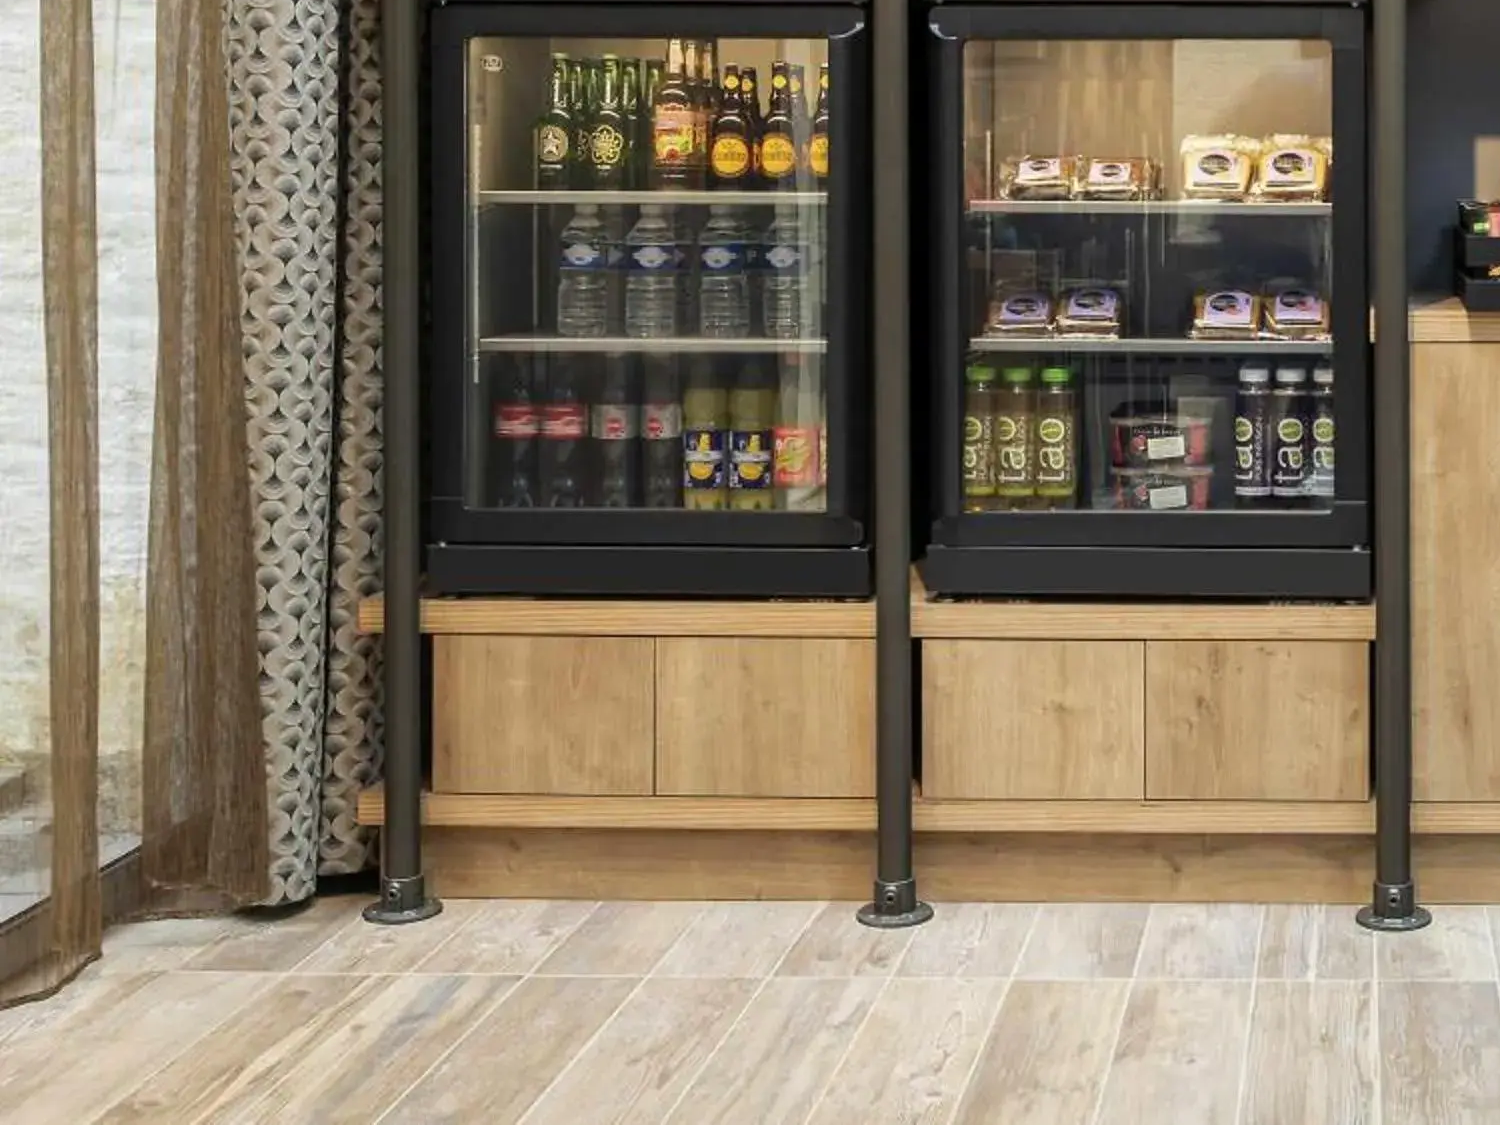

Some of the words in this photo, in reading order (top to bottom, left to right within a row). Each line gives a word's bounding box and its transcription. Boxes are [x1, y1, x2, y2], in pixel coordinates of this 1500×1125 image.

[999, 417, 1025, 483] tao
[1036, 418, 1065, 483] tao
[1274, 418, 1304, 483] tao
[1312, 418, 1335, 481] tao
